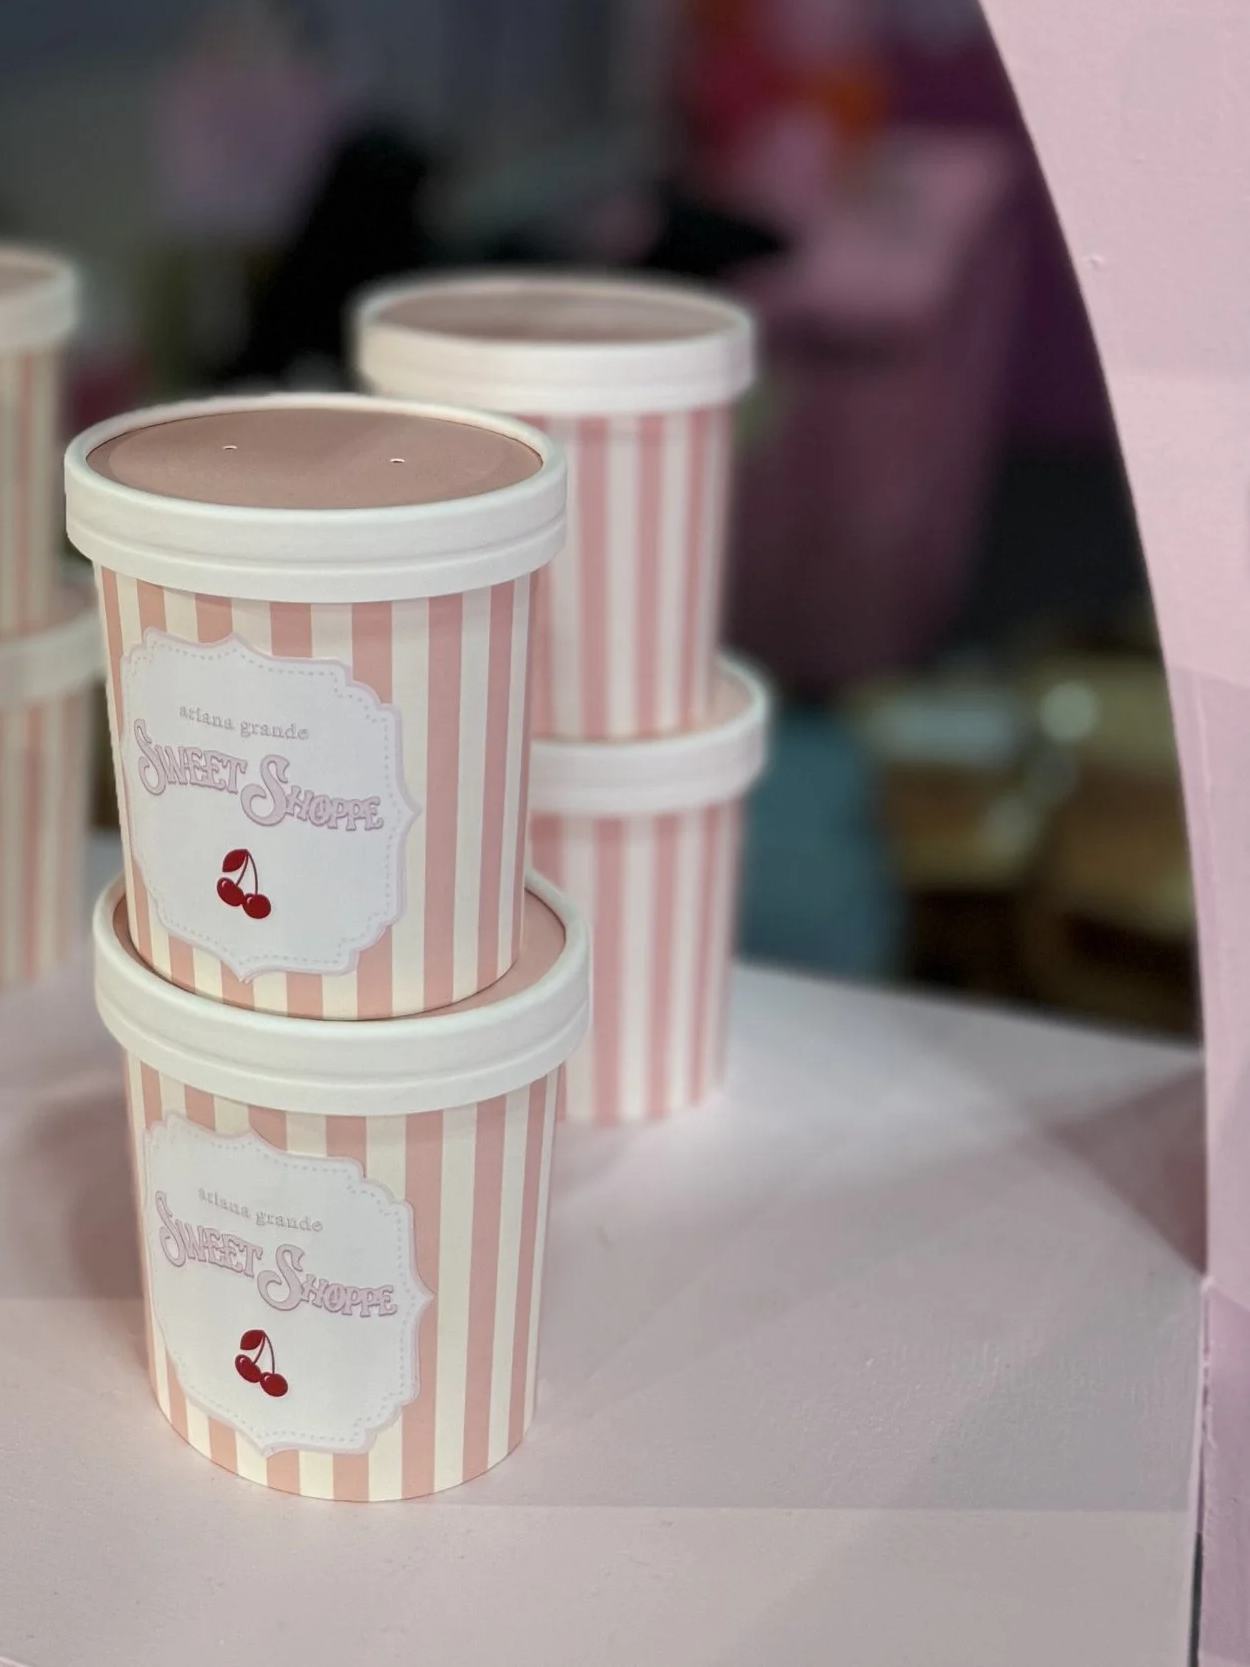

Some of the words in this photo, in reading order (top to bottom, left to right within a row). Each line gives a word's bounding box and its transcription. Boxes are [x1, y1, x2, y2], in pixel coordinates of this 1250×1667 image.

[178, 703, 235, 730] ariana
[240, 721, 310, 741] grande
[133, 717, 248, 796] SWEET
[240, 754, 385, 832] SHOPPE
[198, 1187, 251, 1218] ariana
[255, 1210, 324, 1233] grande
[155, 1190, 264, 1279] SWEET
[256, 1243, 399, 1318] SHOPPE
